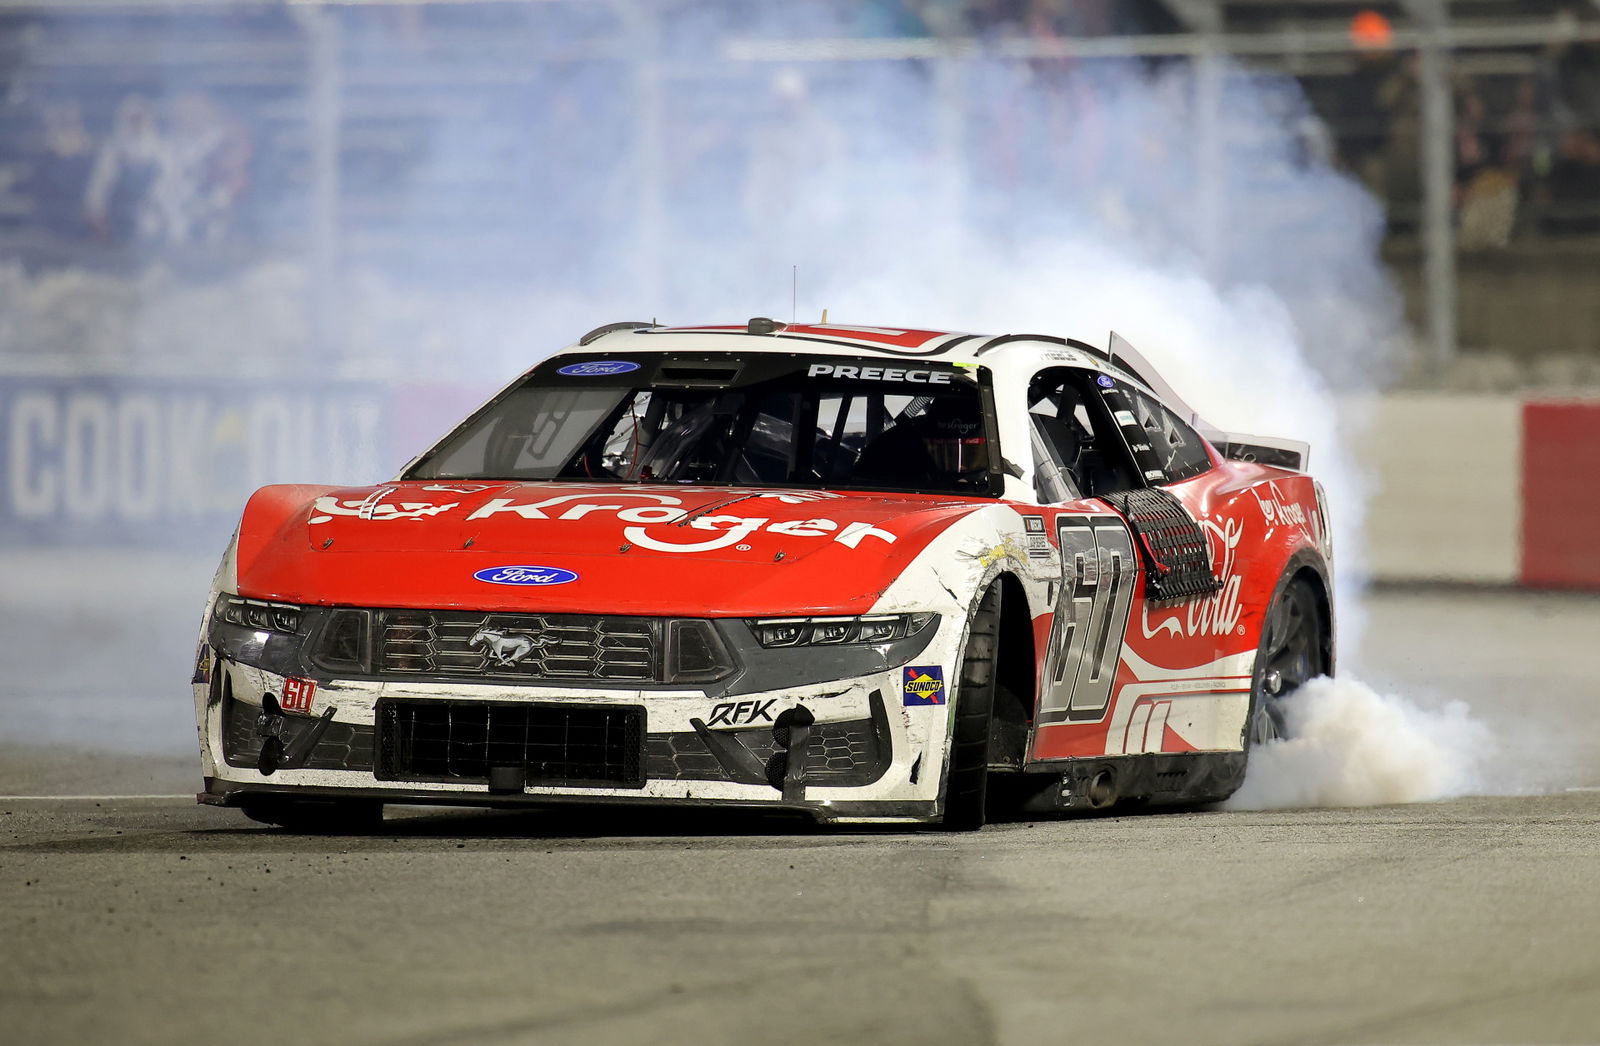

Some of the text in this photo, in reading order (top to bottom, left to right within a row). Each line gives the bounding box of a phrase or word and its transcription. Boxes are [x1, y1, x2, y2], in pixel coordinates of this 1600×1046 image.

[807, 364, 952, 384] PREECE
[11, 393, 211, 517] COOK
[464, 493, 898, 553] Kroger
[1038, 514, 1138, 724] 60
[281, 678, 316, 713] 60
[905, 681, 941, 693] SUNOCO
[709, 698, 777, 726] RFK
